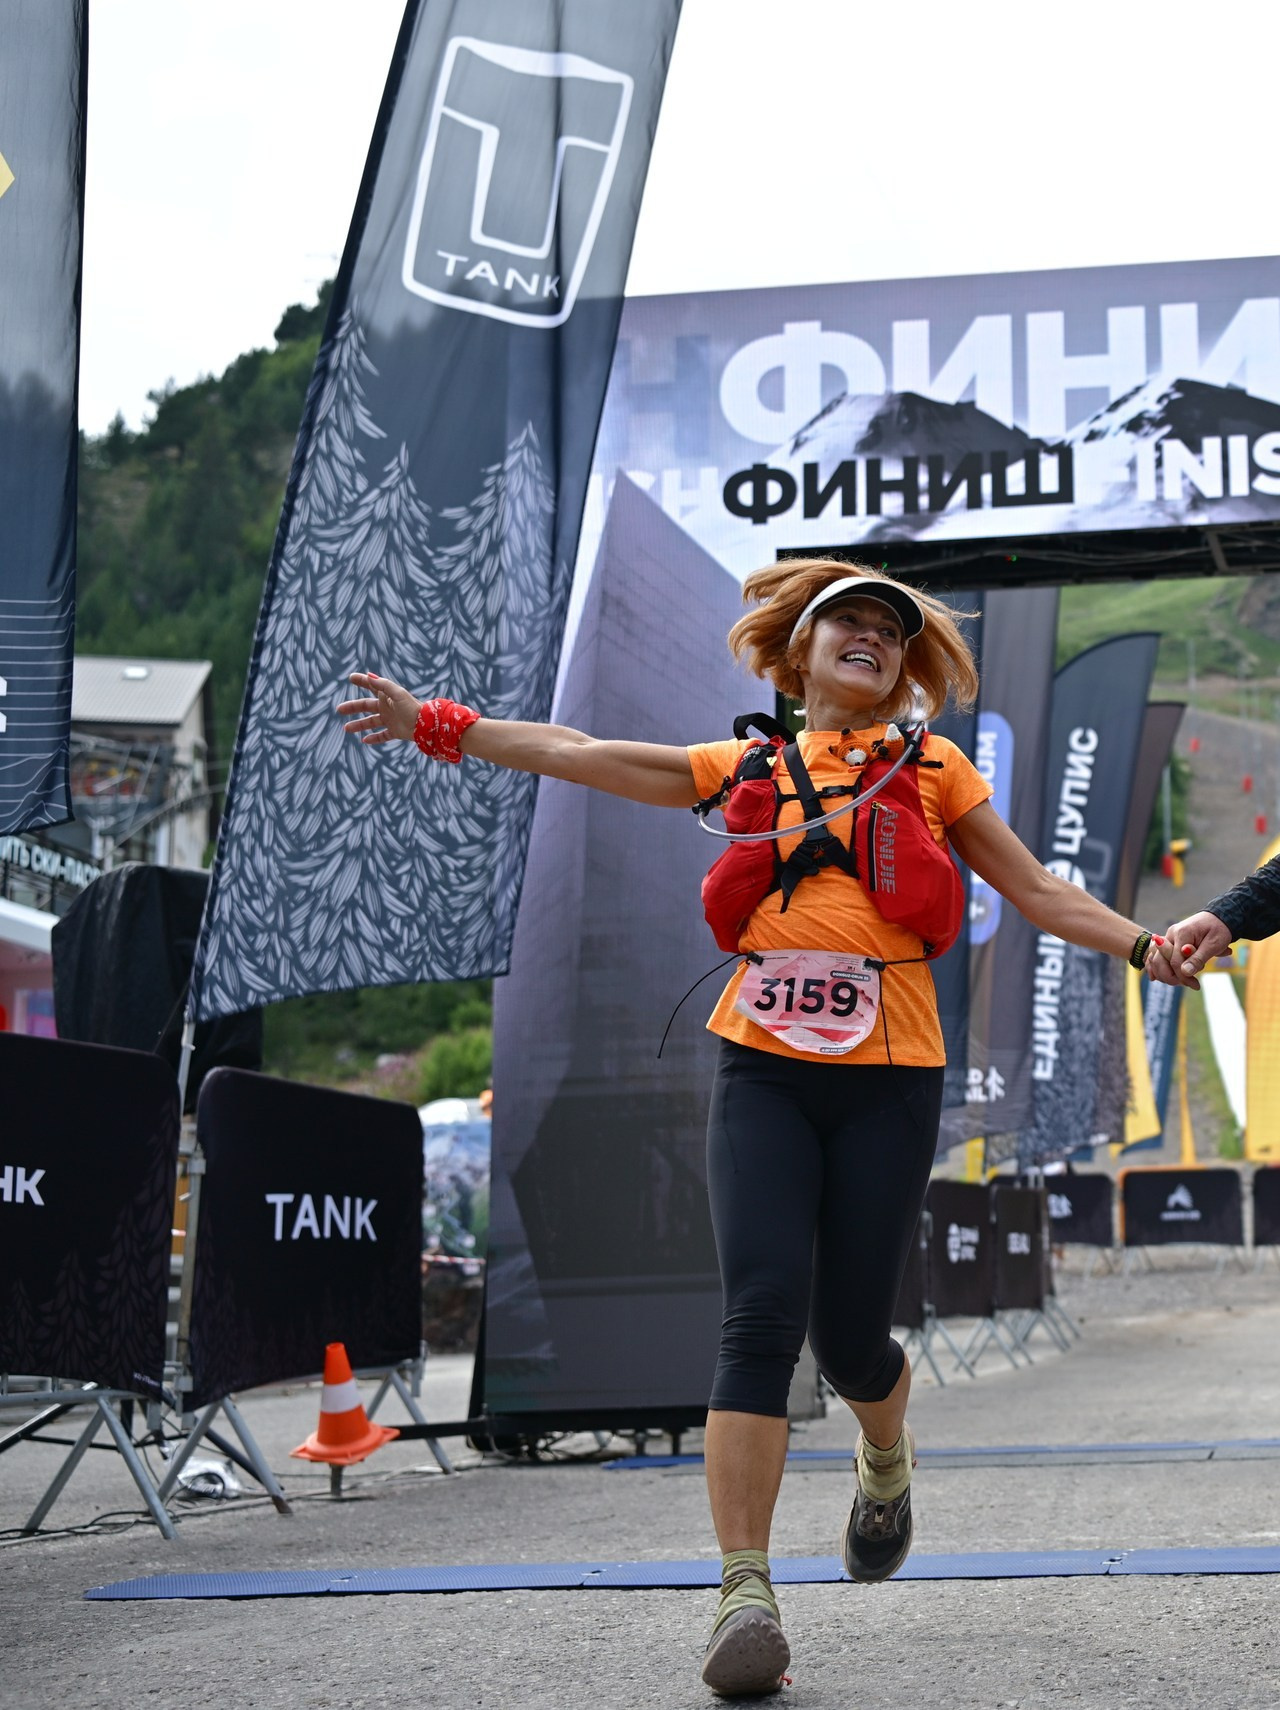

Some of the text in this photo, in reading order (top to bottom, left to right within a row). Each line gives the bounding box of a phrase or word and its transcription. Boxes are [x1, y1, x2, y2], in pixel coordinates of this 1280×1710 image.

[437, 250, 560, 298] TANK
[722, 446, 1074, 525] ФИНИШ
[1052, 727, 1099, 856] ЦУПИС
[880, 809, 898, 894] AONIJIE
[753, 977, 858, 1017] 3159
[266, 1193, 378, 1242] TANK
